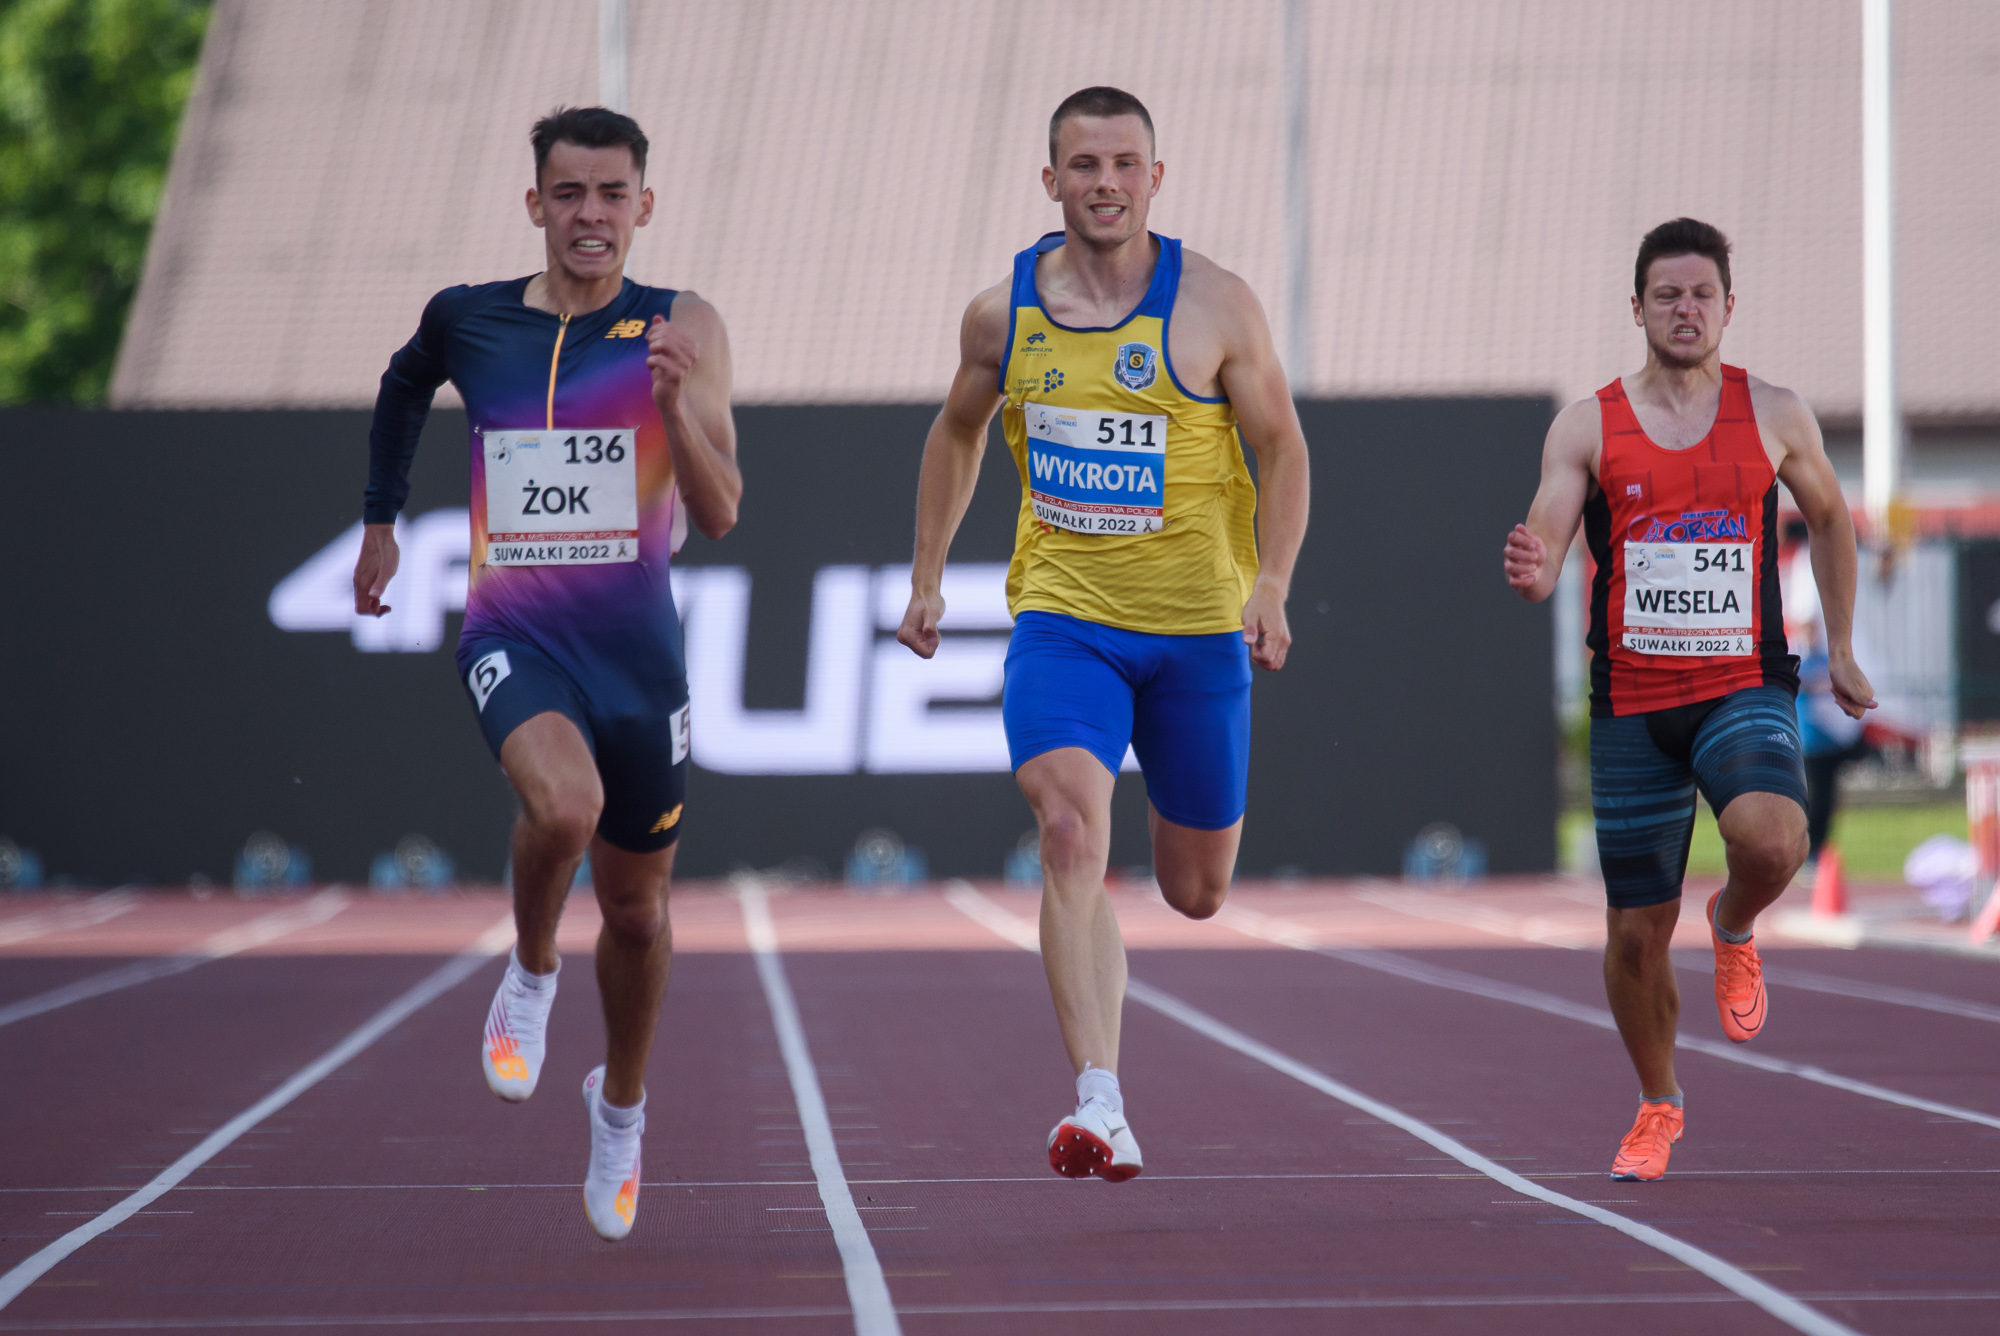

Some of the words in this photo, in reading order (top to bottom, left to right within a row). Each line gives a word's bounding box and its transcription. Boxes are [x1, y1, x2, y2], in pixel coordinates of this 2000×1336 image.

[1132, 355, 1142, 367] S
[1096, 417, 1156, 448] 511
[562, 434, 626, 465] 136
[1032, 450, 1158, 494] WYKROTA
[521, 478, 591, 516] ŻOK
[1044, 496, 1063, 508] PZLA
[1063, 502, 1125, 515] MISTRZOSTWA
[1126, 507, 1158, 516] POLSKI
[1036, 504, 1093, 530] SUWAŁKI
[1097, 518, 1137, 532] 2022
[1663, 514, 1747, 544] ORKAN
[504, 533, 525, 542] PZLA
[527, 532, 596, 542] MISTRZOSTWA
[597, 530, 632, 540] POLSKI
[494, 546, 563, 562] SUWAŁKI
[568, 545, 610, 559] 2022
[1693, 548, 1745, 573] 541
[1635, 588, 1741, 614] WESELA
[1642, 627, 1661, 635] PZLA
[1662, 628, 1720, 636] MISTRZOSTWA
[1720, 628, 1748, 636] POLSKI
[1629, 638, 1691, 652] SUWAŁKI
[1695, 640, 1730, 652] 2022
[474, 656, 498, 697] 5
